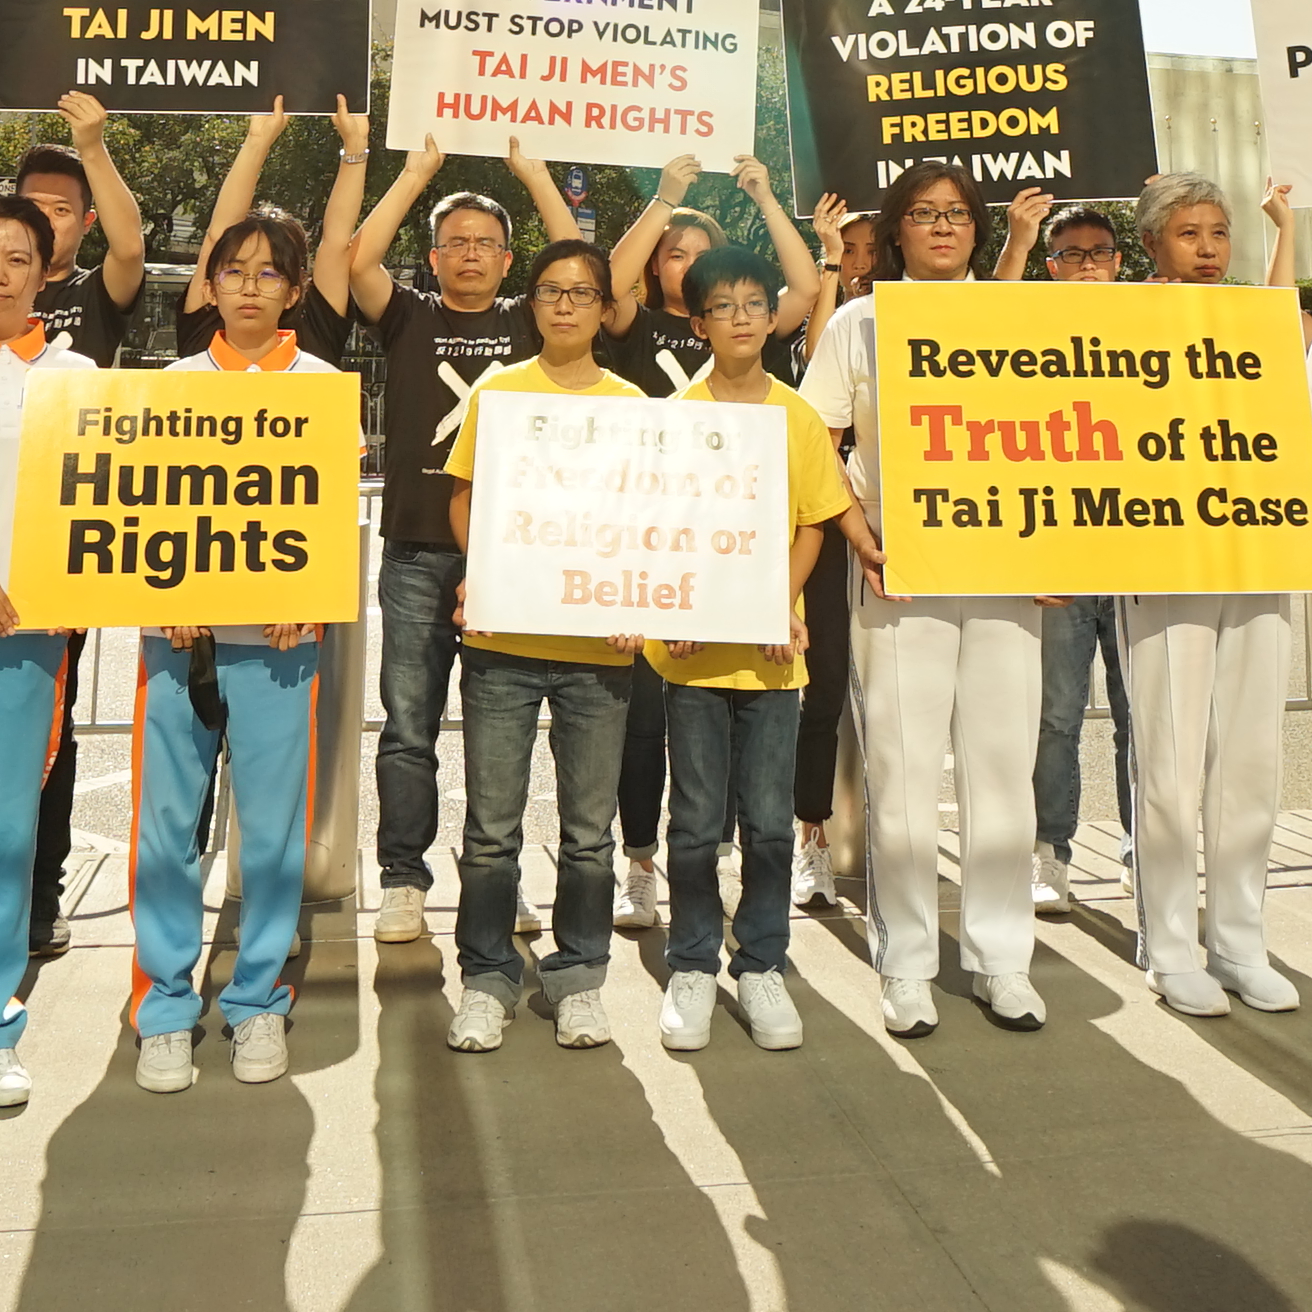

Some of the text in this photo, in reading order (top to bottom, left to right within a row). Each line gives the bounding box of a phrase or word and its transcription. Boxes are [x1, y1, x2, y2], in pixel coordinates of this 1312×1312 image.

[63, 8, 274, 42] TAI JI MEN
[420, 8, 737, 53] MUST STOP VIOLATING
[831, 21, 1094, 62] VIOLATION OF
[77, 58, 258, 86] IN TAIWAN
[472, 50, 687, 91] TAI JI MEN'S
[867, 63, 1068, 102] RELIGIOUS
[437, 92, 713, 137] HUMAN RIGHTS
[882, 107, 1059, 144] FREEDOM
[922, 150, 1071, 182] IWAN
[908, 336, 1261, 389] Revealing the
[78, 407, 308, 445] Fighting for
[910, 401, 1278, 462] Truth of the
[60, 453, 318, 506] Human
[714, 464, 759, 501] of
[913, 486, 1308, 538] Tai Ji Men Case
[67, 516, 308, 589] Rights
[502, 509, 757, 559] Religion or
[561, 569, 697, 610] Belief
